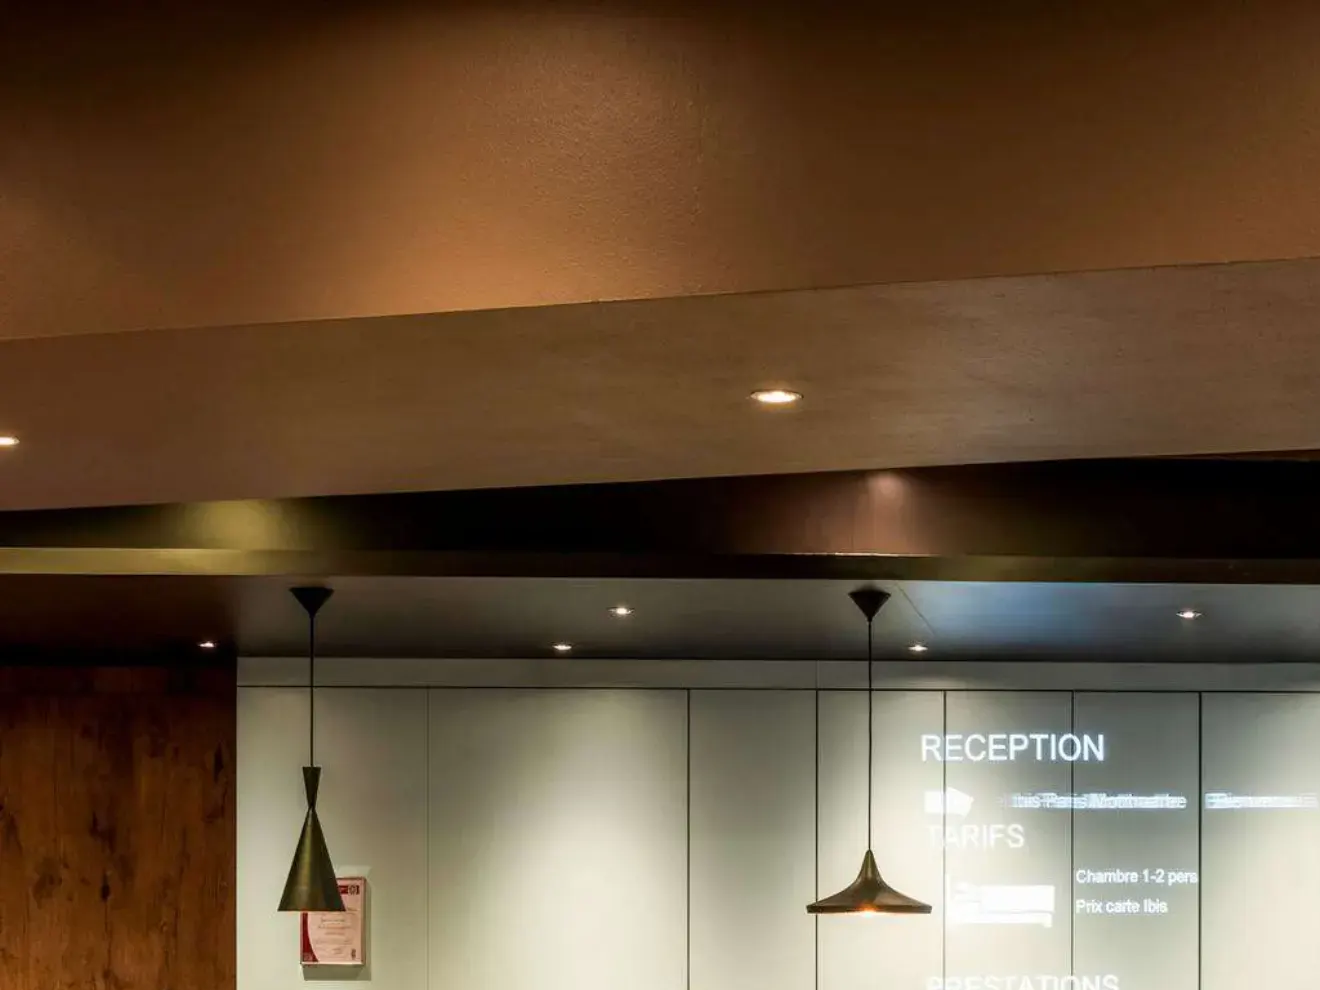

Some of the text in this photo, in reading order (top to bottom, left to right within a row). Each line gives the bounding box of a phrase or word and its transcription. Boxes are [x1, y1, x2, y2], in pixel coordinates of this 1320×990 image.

[921, 733, 1105, 762] RECEPTION
[926, 824, 1025, 849] TARIFS
[1076, 868, 1198, 886] Chambre 1-2 pers
[1076, 898, 1168, 914] Prix carte Ibis
